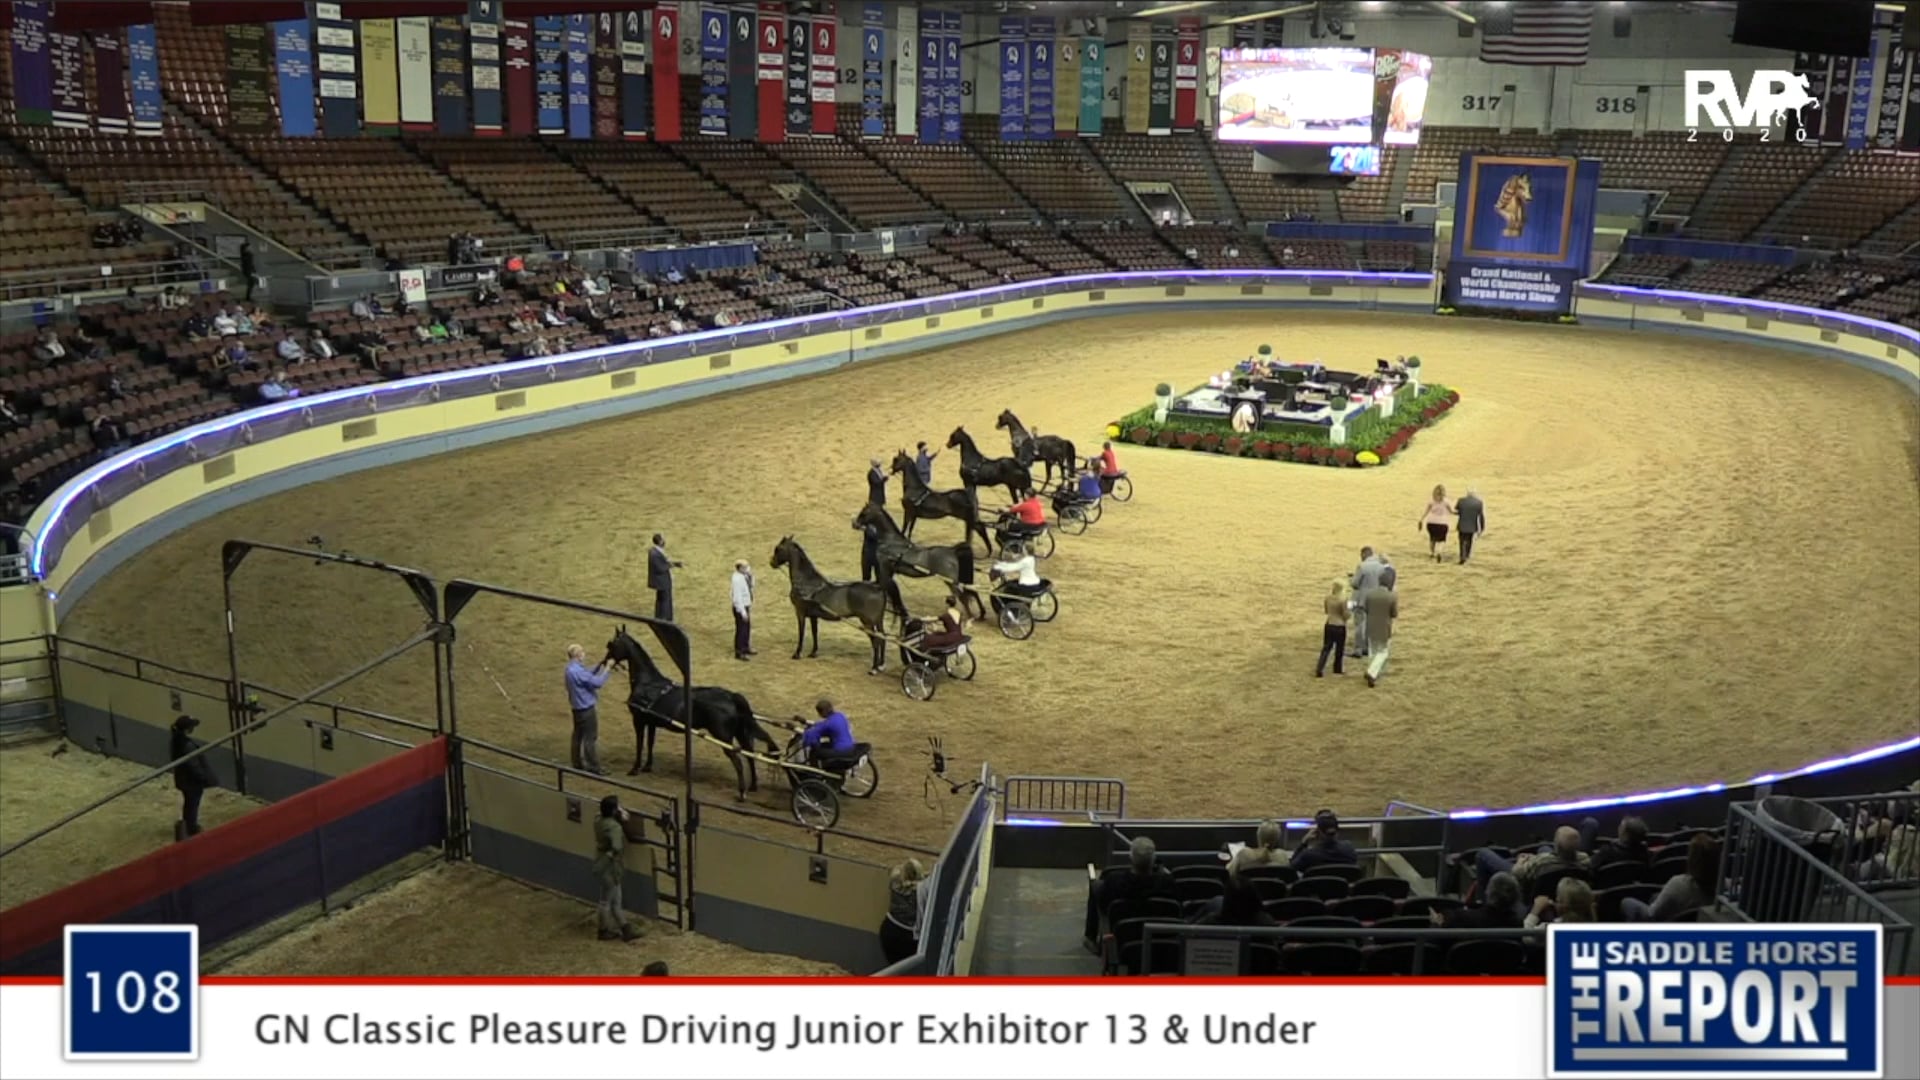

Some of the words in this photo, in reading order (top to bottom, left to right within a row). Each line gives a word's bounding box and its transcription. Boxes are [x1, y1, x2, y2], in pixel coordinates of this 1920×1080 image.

[835, 68, 857, 84] 12
[1462, 95, 1502, 111] 317
[1595, 97, 1637, 113] 318
[1471, 267, 1500, 278] Grand
[1501, 268, 1543, 281] National
[1460, 277, 1489, 288] World
[1490, 278, 1561, 294] Championship
[1461, 287, 1498, 299] Morgan
[1498, 290, 1527, 301] Horse
